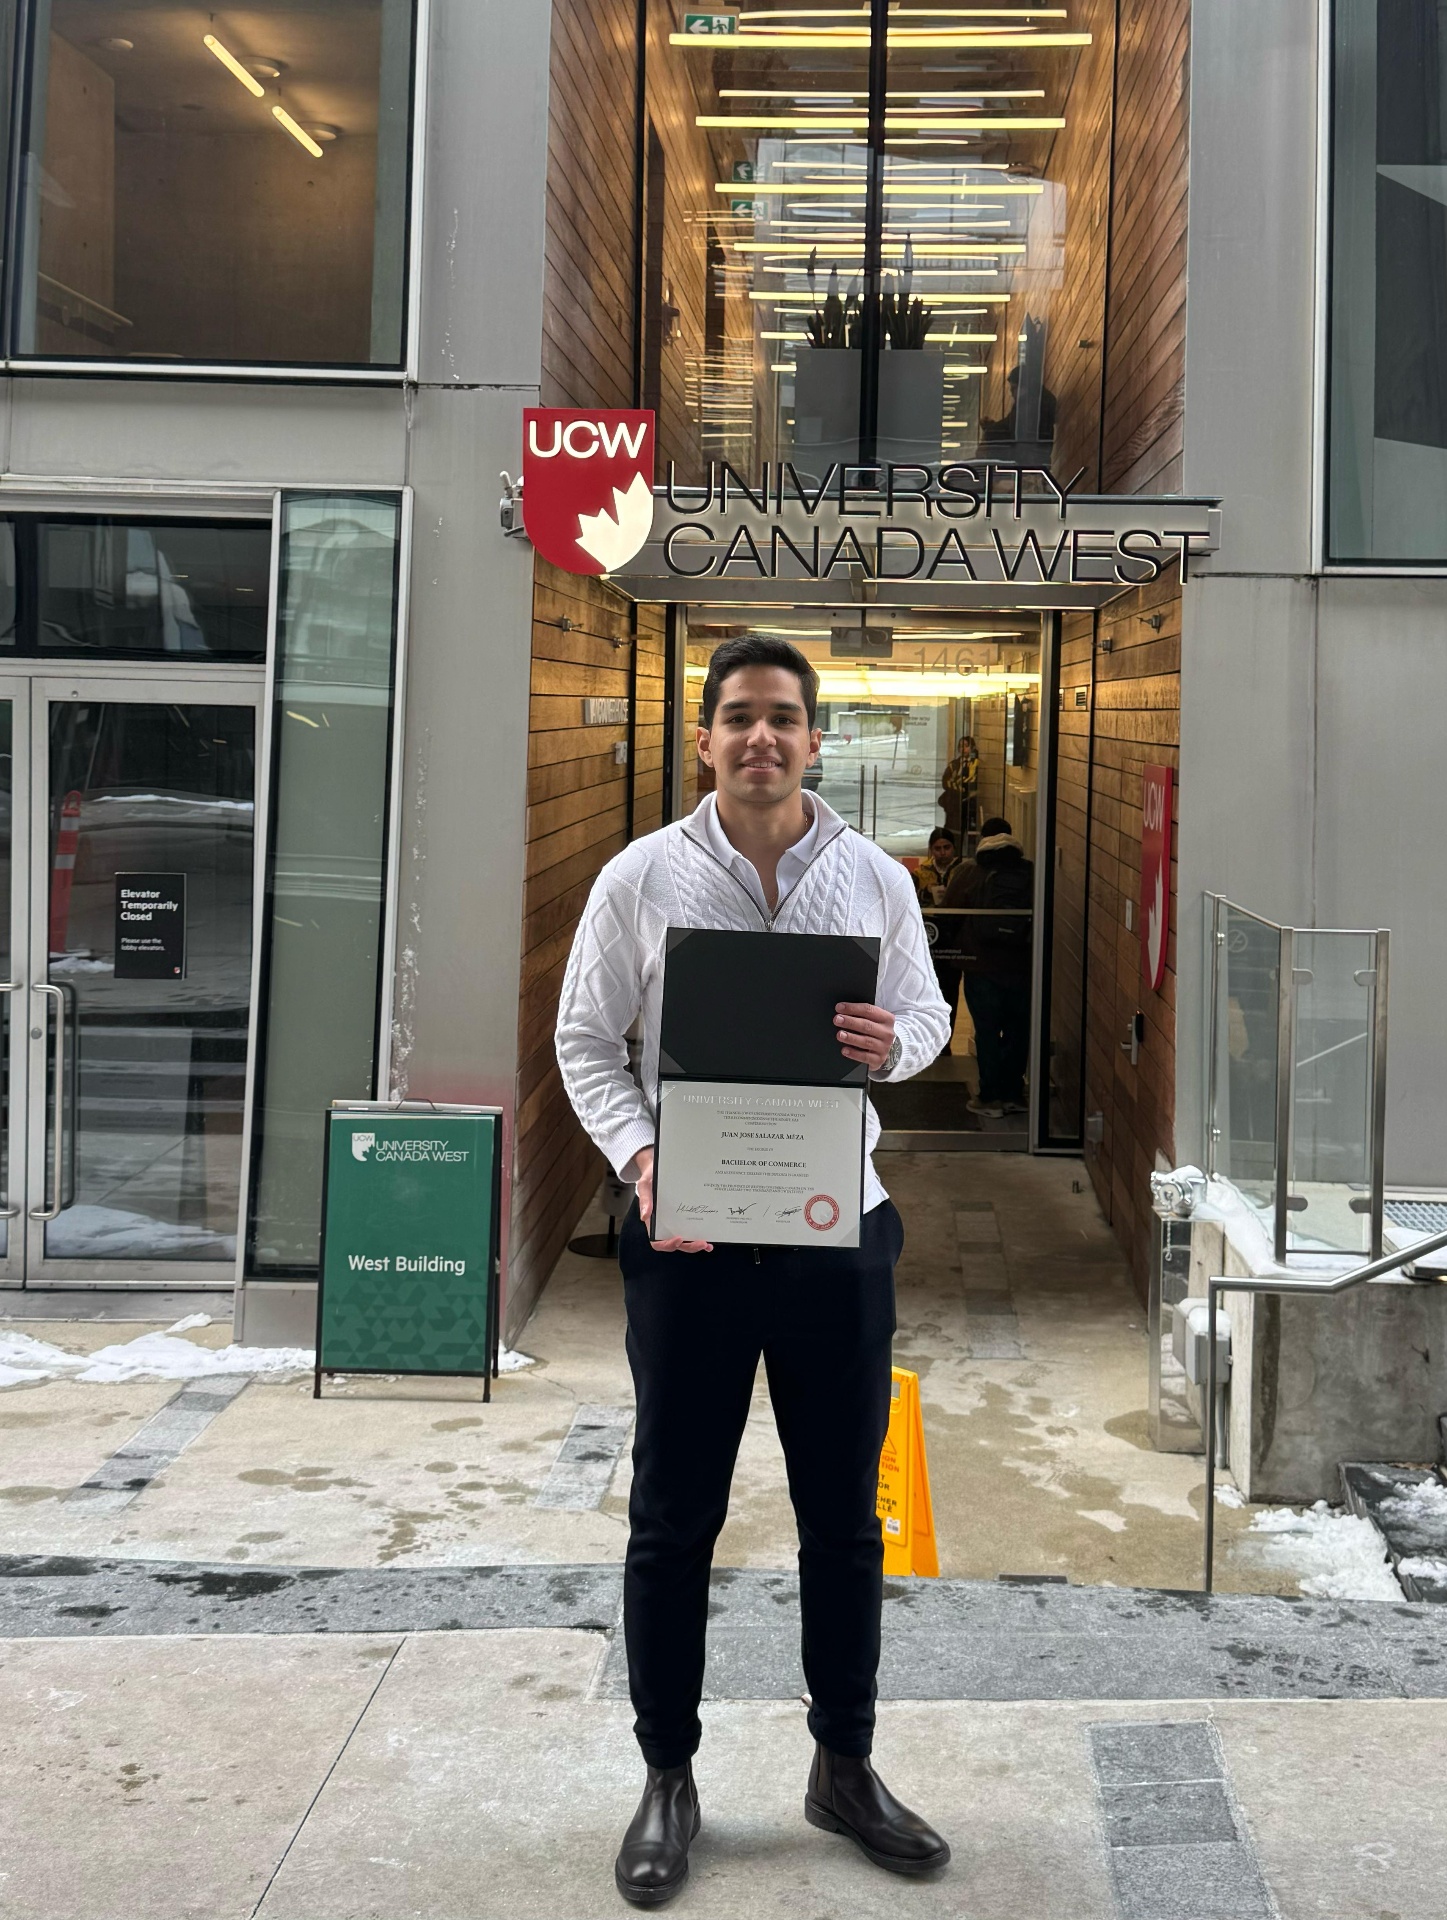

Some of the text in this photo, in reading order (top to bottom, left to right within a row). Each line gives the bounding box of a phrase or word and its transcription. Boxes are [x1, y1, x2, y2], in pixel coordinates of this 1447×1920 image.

[529, 420, 647, 459] UCW
[666, 460, 1089, 520] UNIVERSITY
[663, 522, 1212, 586] CANADA WEST
[914, 646, 992, 677] 1461
[1143, 781, 1165, 833] UCW
[120, 889, 161, 899] Elevator
[120, 900, 179, 912] Temporarily
[120, 911, 153, 921] Closed
[683, 1094, 752, 1106] UNIVERSITY
[375, 1140, 449, 1151] UNIVERSITY
[375, 1151, 470, 1162] CANADA WEST
[768, 1160, 807, 1168] COMMERCE
[348, 1255, 466, 1276] West Building
